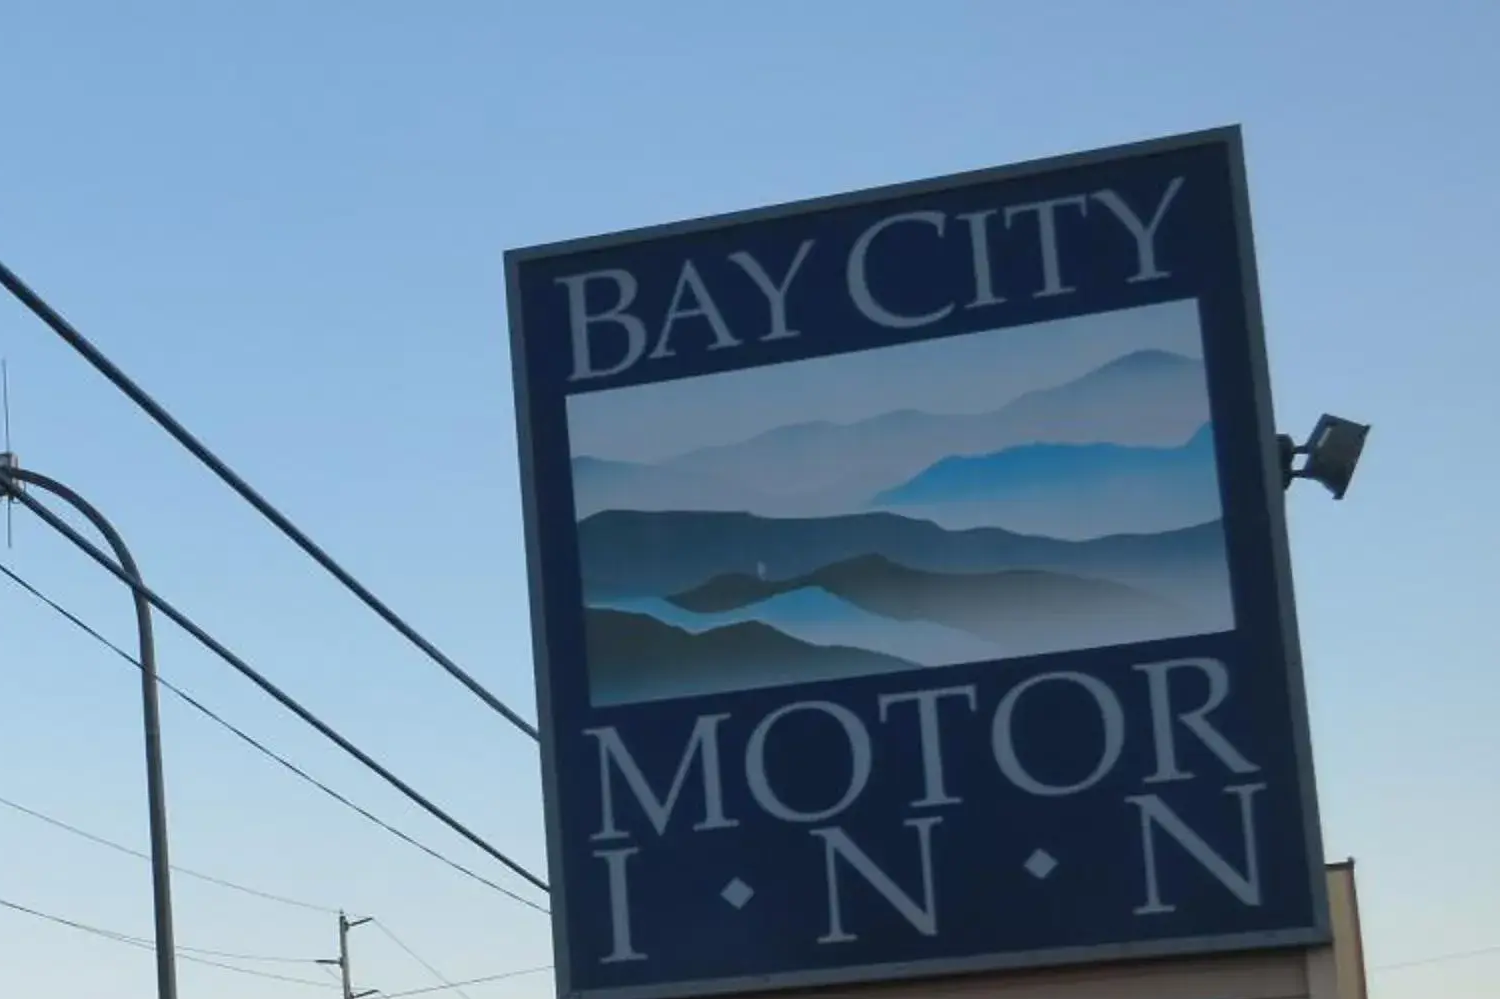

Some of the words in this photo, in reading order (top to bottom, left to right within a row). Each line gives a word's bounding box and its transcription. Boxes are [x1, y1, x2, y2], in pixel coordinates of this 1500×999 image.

[557, 239, 816, 383] BAY
[846, 177, 1186, 329] CITY
[583, 656, 1261, 843] MOTOR
